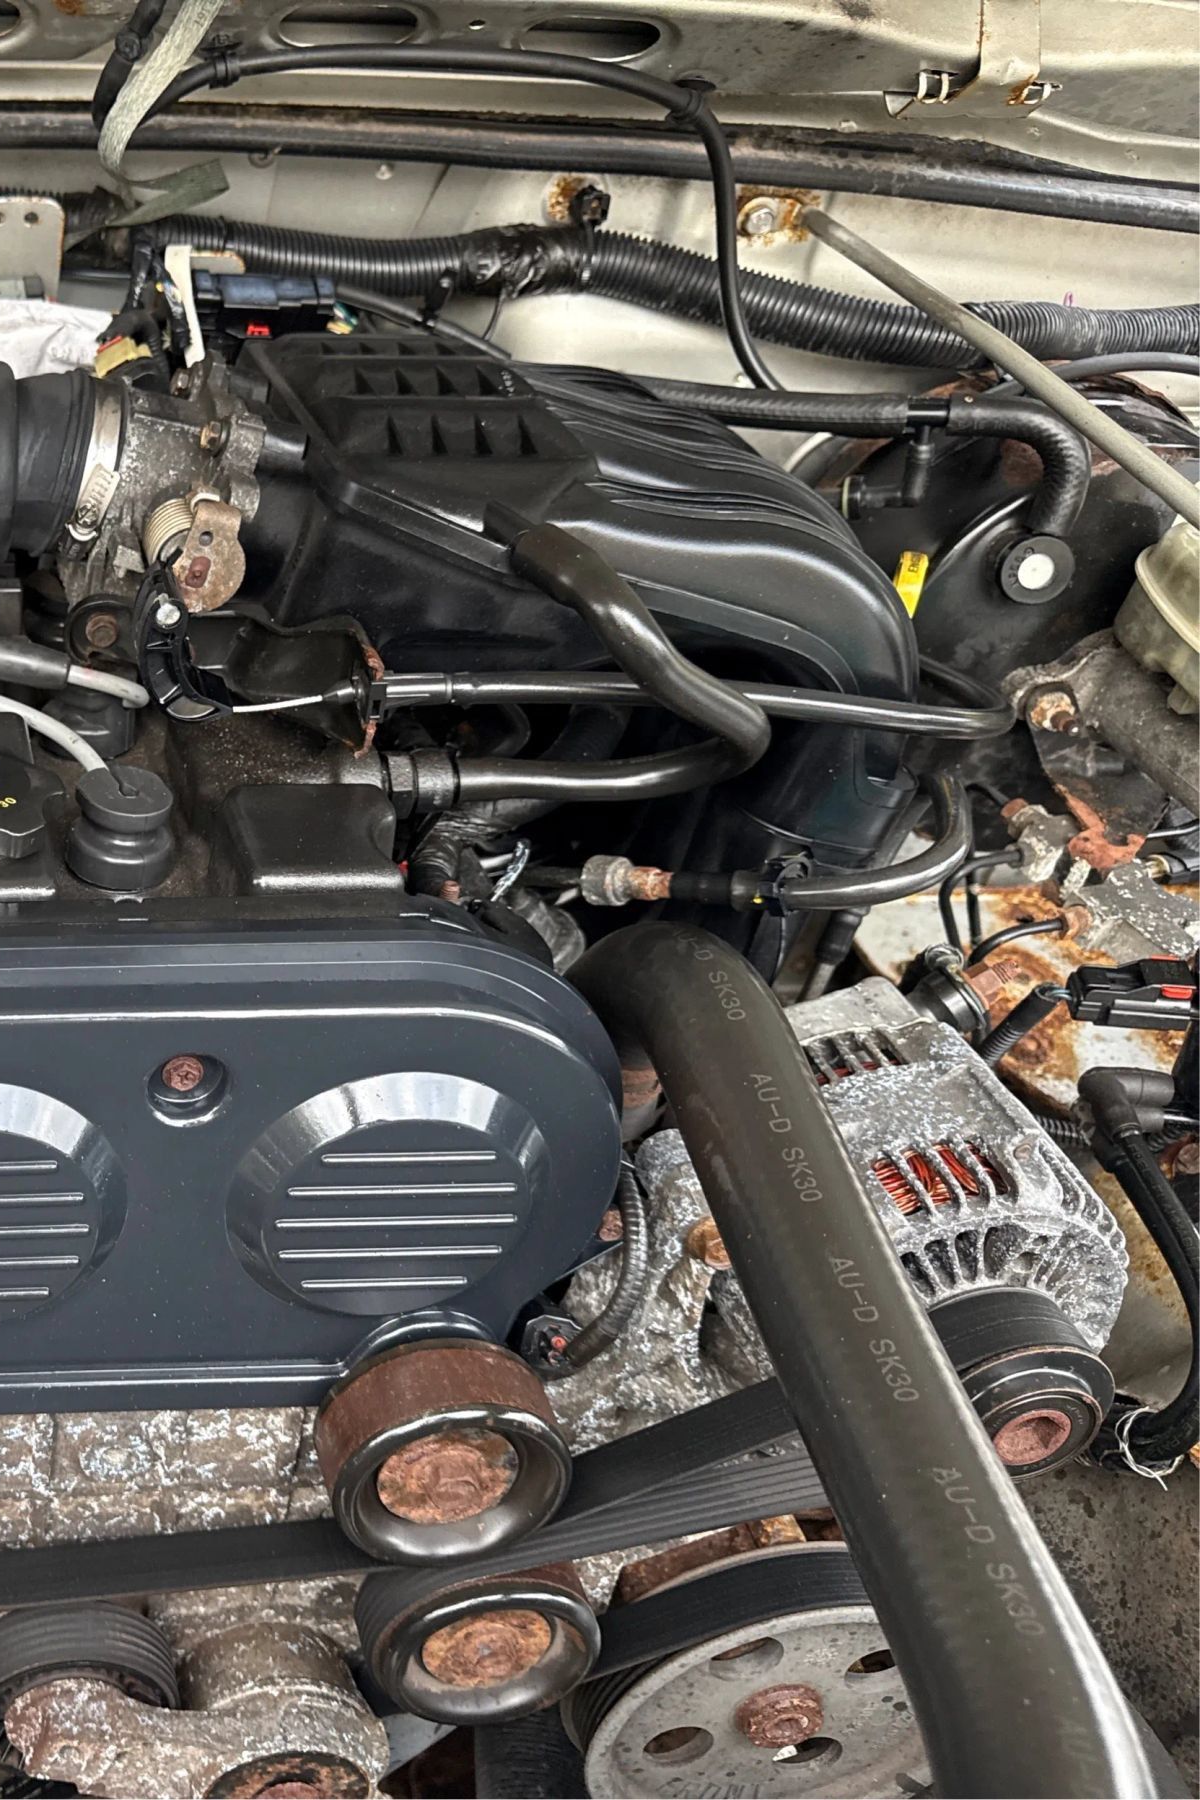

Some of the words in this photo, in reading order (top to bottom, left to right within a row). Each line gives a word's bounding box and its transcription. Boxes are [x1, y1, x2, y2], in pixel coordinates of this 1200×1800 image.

[708, 970, 746, 1020] SK30
[749, 1073, 792, 1133] AU-D
[782, 1147, 823, 1202] SK30
[829, 1257, 879, 1322] AU-D
[869, 1338, 919, 1401] SK30
[931, 1466, 995, 1543] AU-D
[986, 1562, 1046, 1635] SK30
